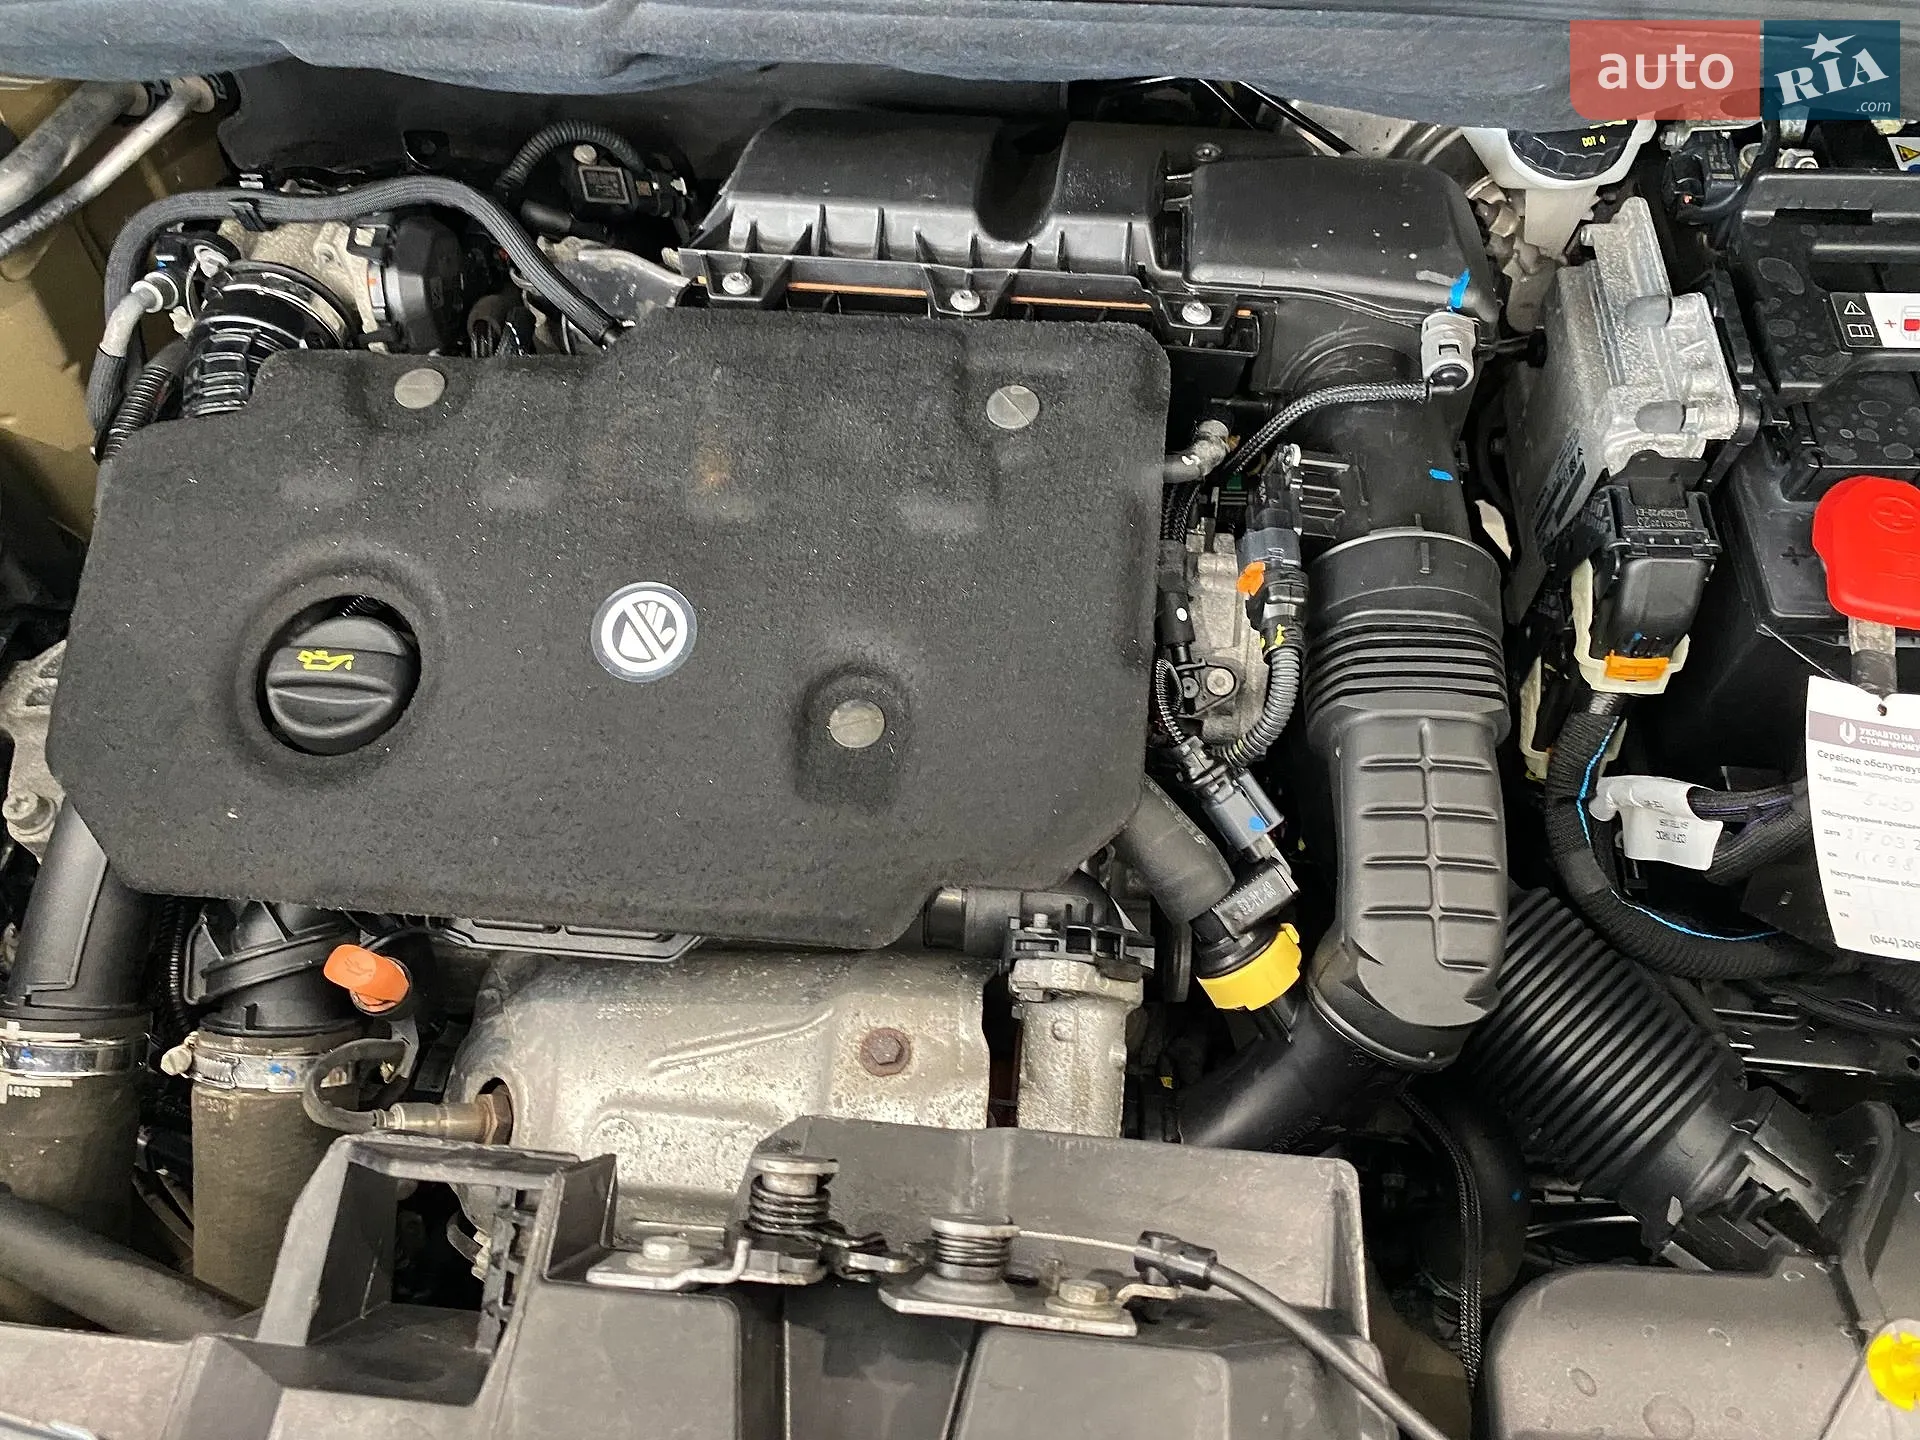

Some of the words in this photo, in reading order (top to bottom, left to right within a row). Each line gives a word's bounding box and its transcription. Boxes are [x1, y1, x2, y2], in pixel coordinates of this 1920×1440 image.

[1582, 136, 1597, 147] DOT
[1599, 134, 1606, 144] 4
[1817, 749, 1861, 765] Сервісне
[1869, 933, 1900, 949] (044)
